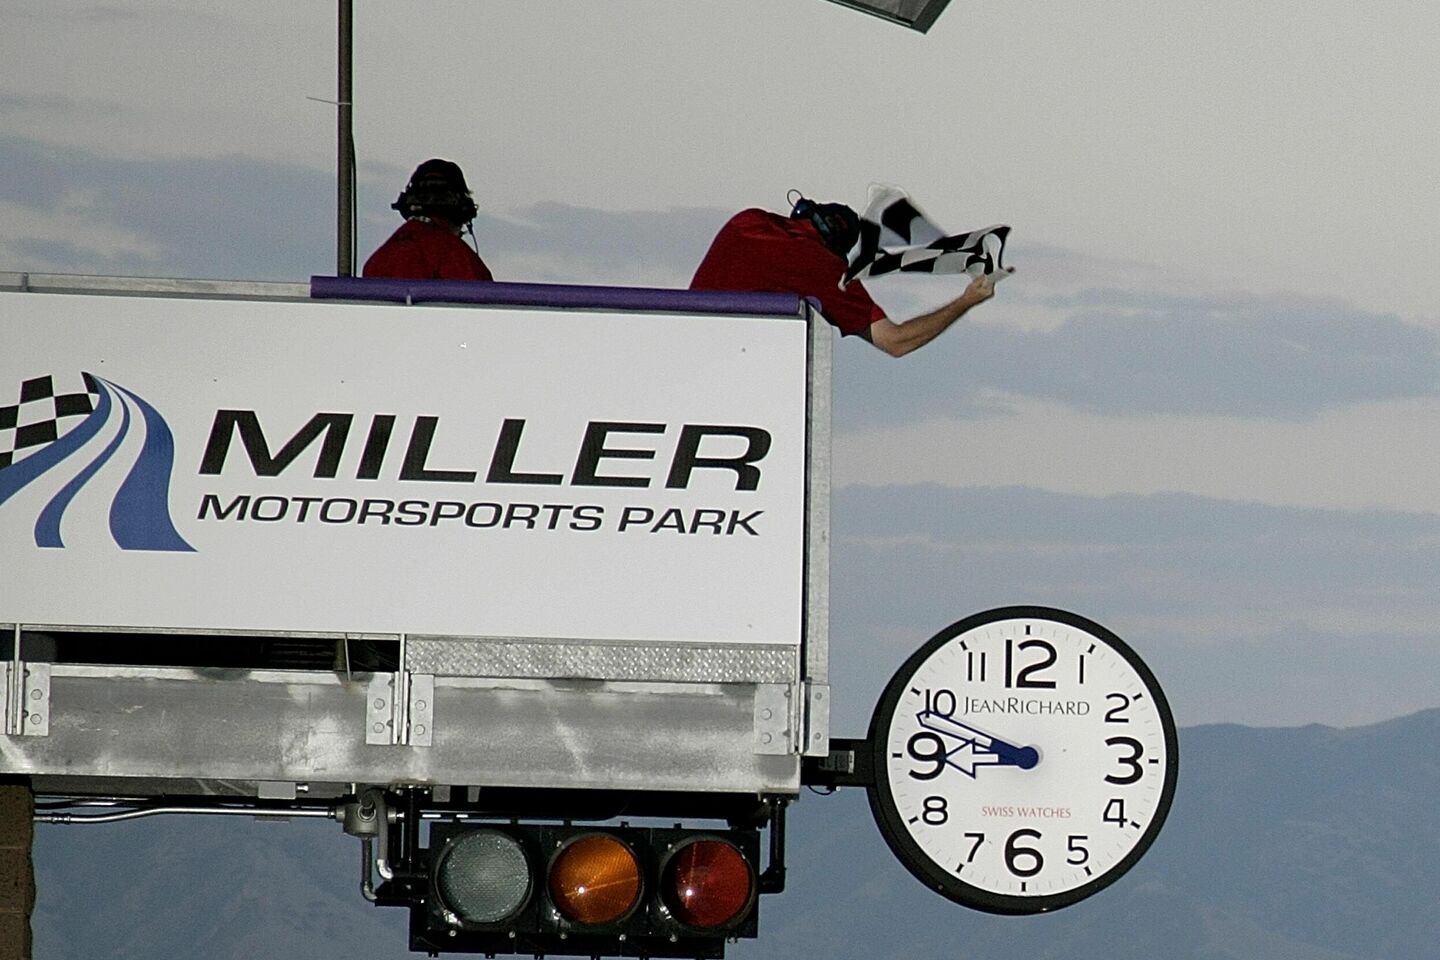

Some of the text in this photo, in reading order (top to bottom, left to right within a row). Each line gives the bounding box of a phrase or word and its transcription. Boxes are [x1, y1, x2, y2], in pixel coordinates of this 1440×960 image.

[198, 409, 773, 492] MILLER
[197, 494, 766, 537] MOTORSPORTS PARK
[967, 652, 987, 682] 11
[1004, 638, 1057, 690] 12
[1078, 654, 1085, 685] 1
[925, 689, 957, 719] 10
[1104, 693, 1130, 723] 2
[907, 731, 947, 781] 9
[1103, 736, 1144, 785] 3
[921, 796, 949, 826] 8
[981, 806, 1072, 819] SWISS WATCHES
[1103, 798, 1128, 828] 4
[964, 832, 985, 863] 7
[1004, 828, 1045, 878] 6
[1066, 835, 1090, 866] 5
